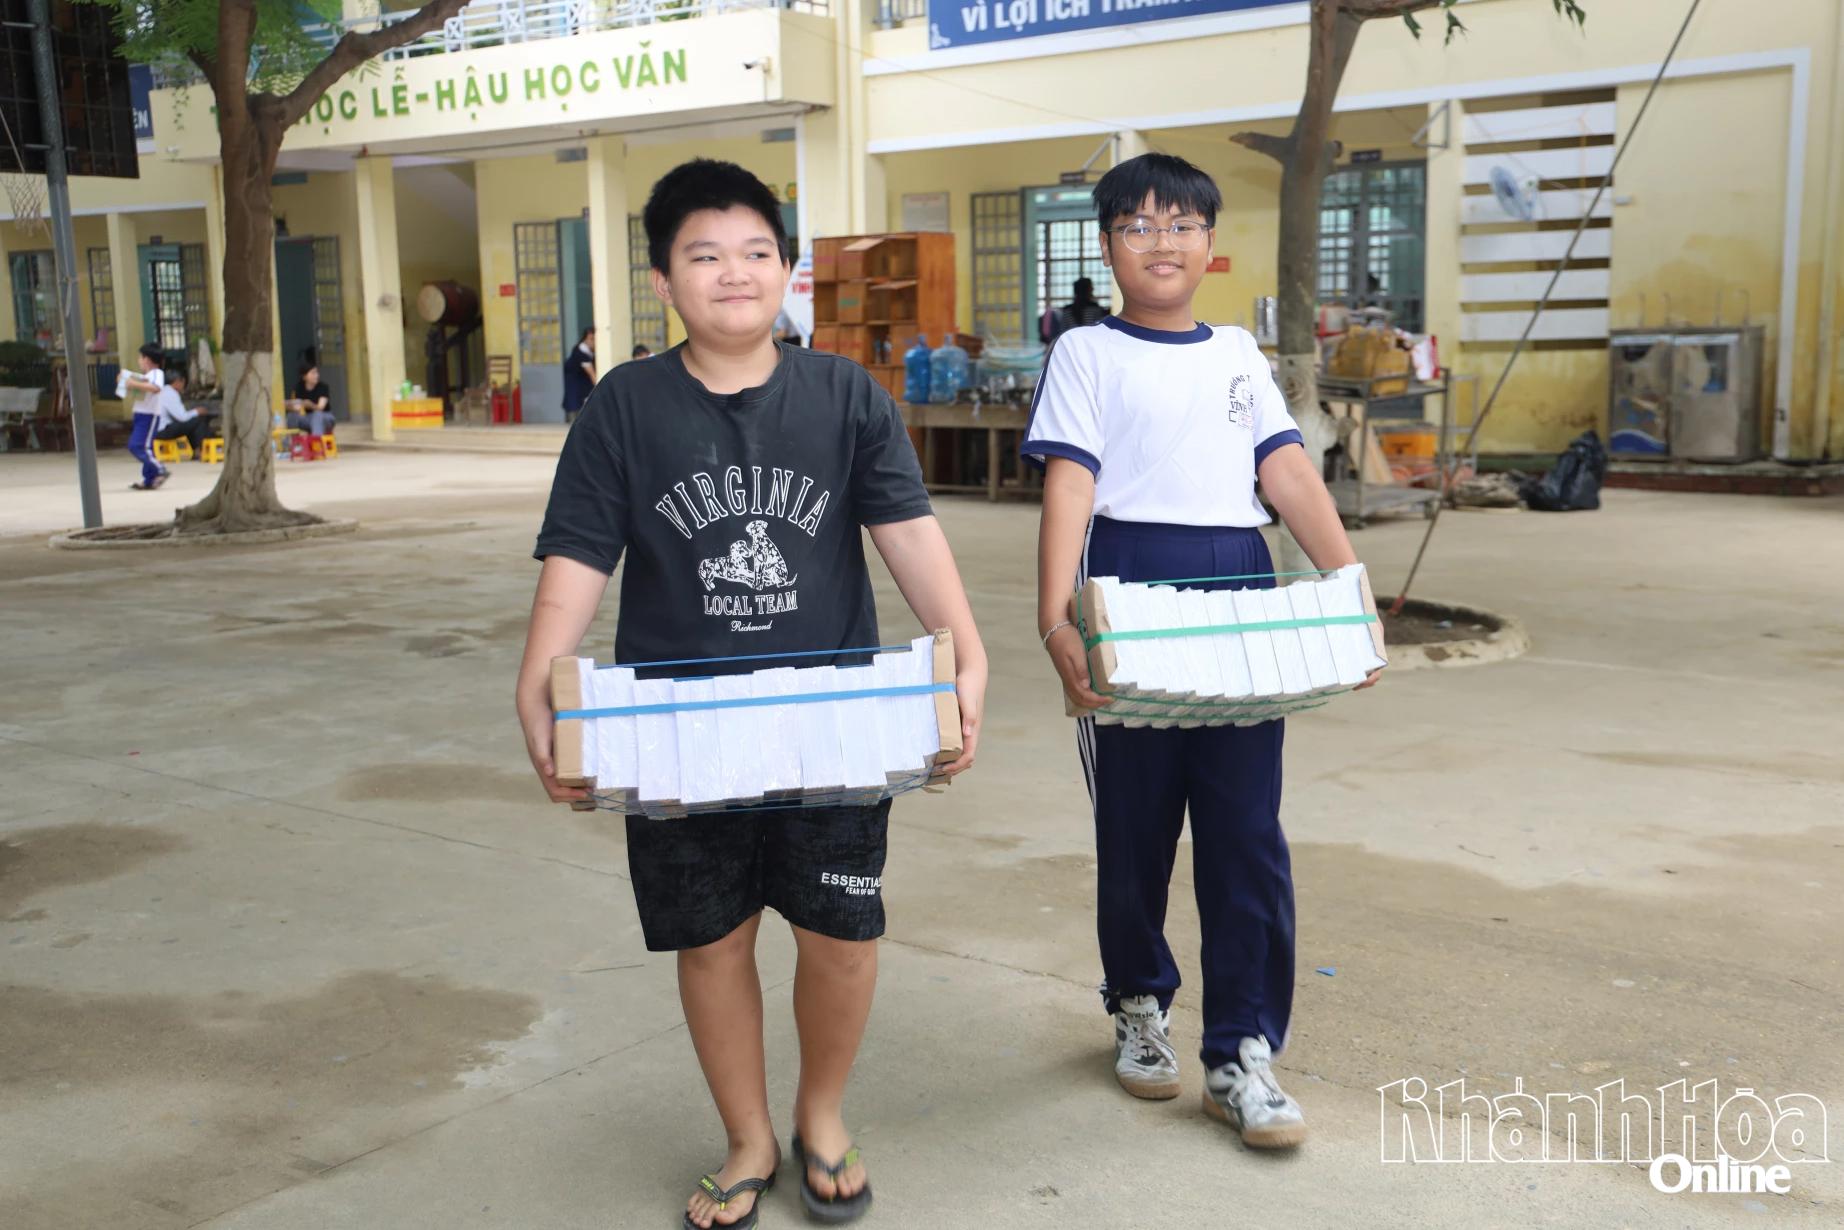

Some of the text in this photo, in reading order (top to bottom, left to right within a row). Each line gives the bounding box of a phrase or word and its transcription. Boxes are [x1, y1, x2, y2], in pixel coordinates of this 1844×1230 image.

[523, 60, 600, 111] HỌC
[612, 39, 687, 89] VĂN
[656, 466, 830, 539] VIRGINIA
[703, 590, 799, 616] LOCAL TEAM
[730, 620, 773, 632] Richmond
